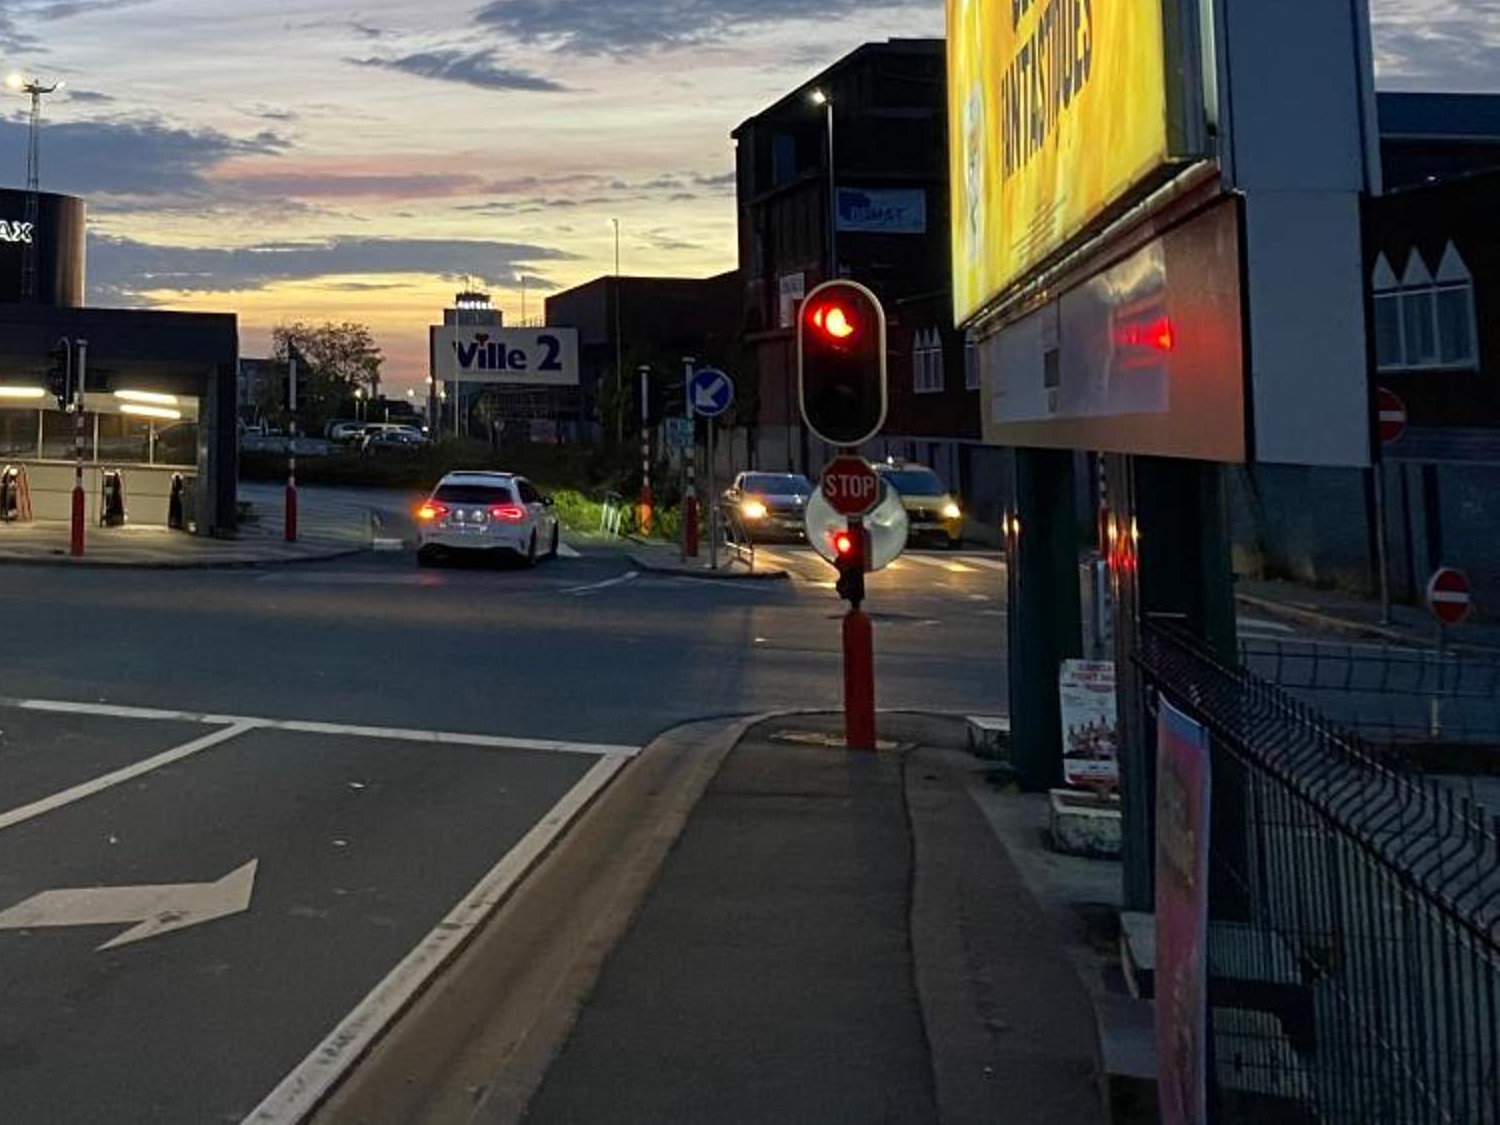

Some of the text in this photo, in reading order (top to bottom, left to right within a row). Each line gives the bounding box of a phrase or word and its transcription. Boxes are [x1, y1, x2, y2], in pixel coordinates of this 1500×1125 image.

[452, 333, 563, 371] Ville 2
[826, 474, 874, 497] STOP
